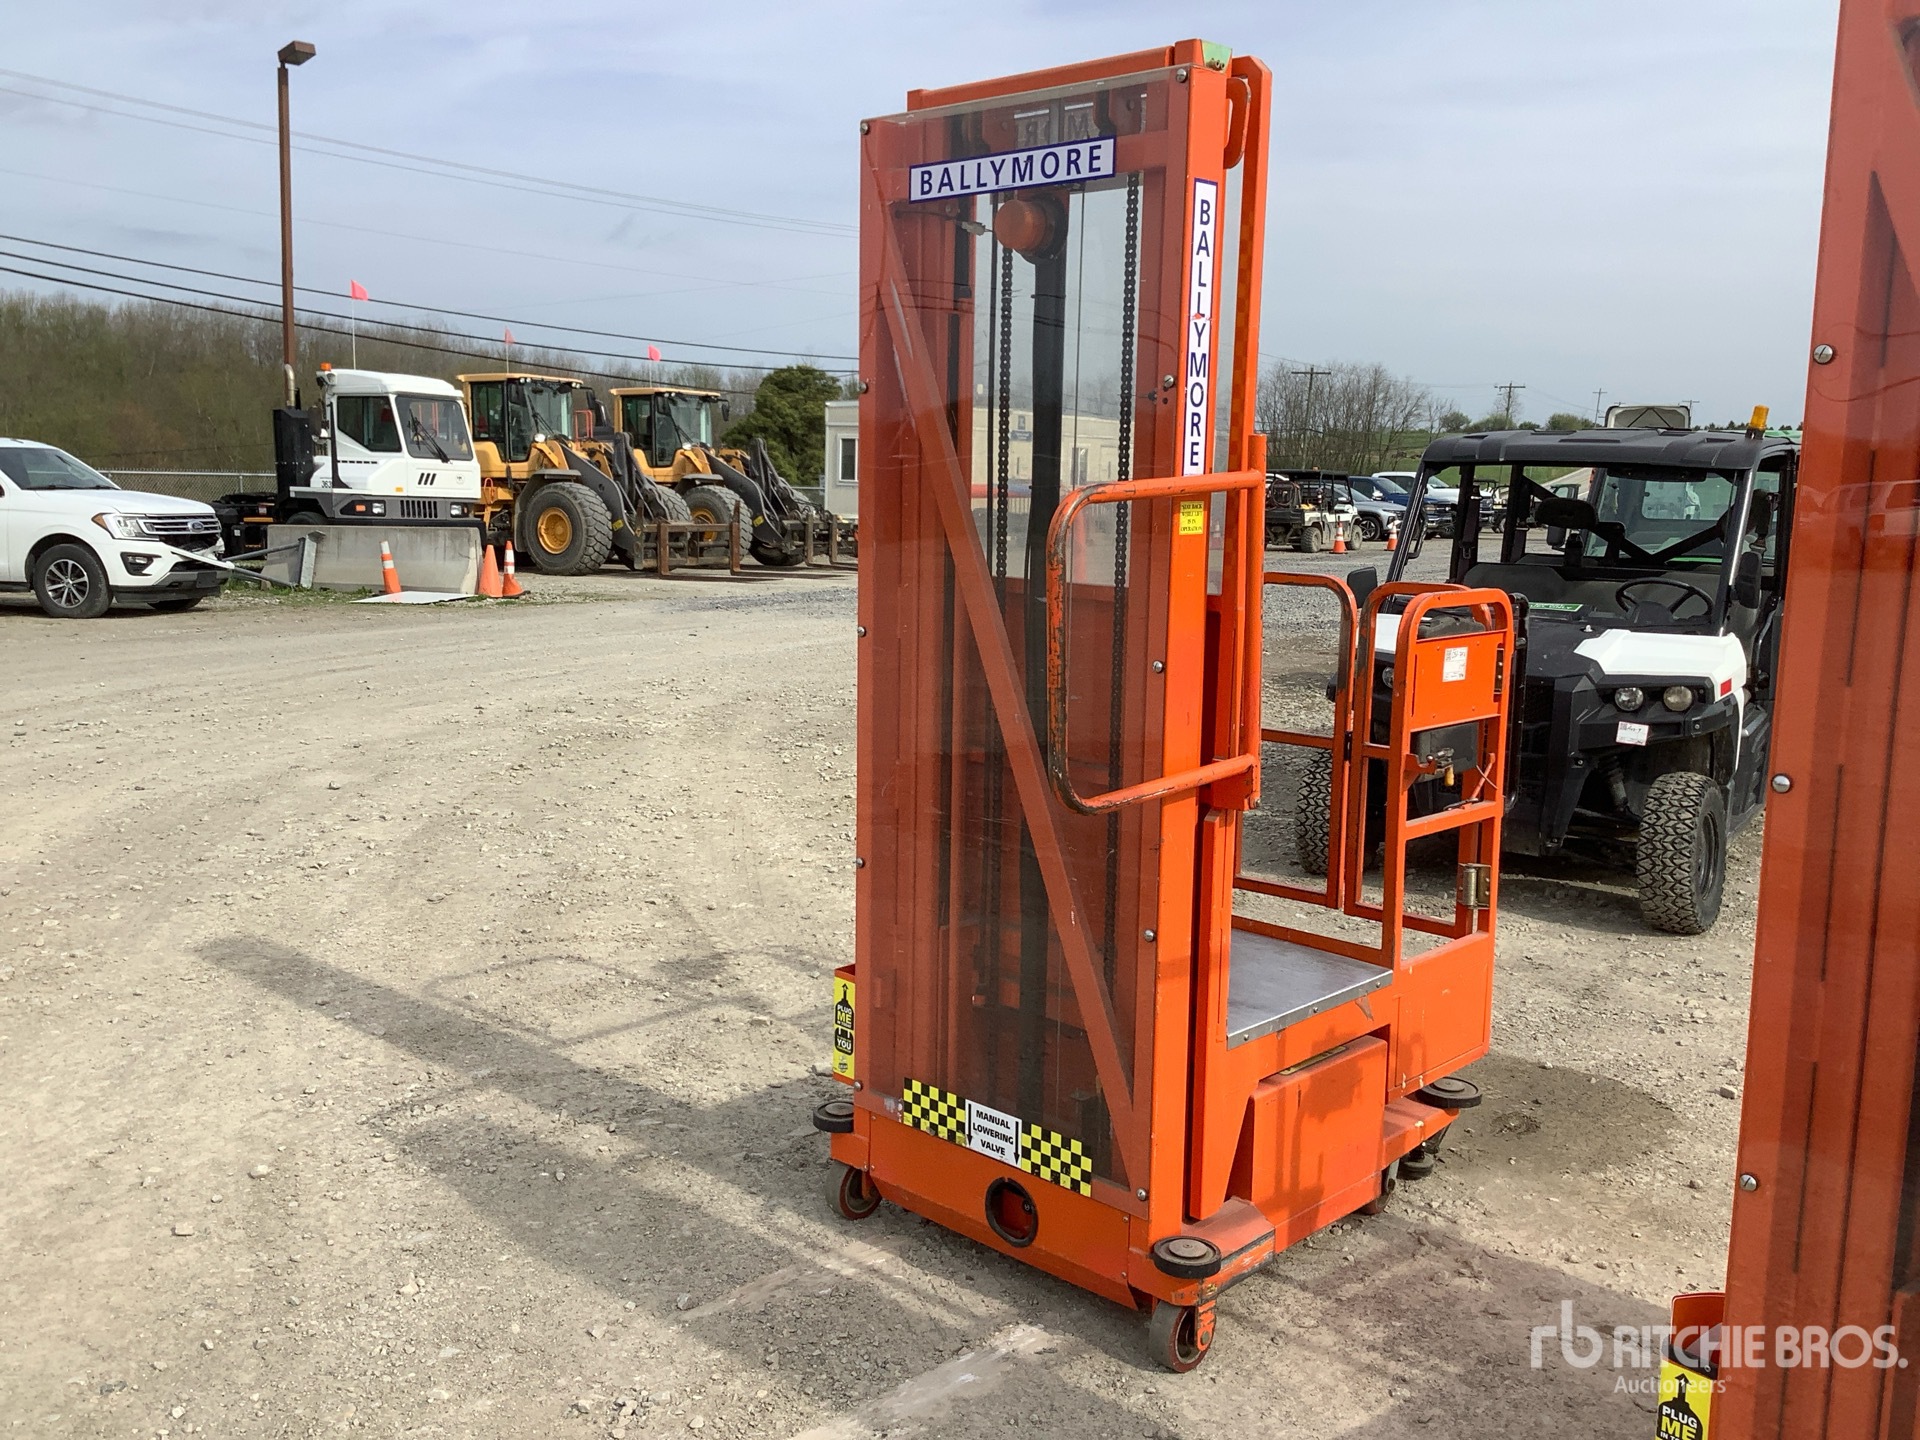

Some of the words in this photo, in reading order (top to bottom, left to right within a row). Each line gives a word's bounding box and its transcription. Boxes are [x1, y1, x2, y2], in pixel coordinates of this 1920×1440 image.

[920, 144, 1102, 196] BALLYMORE
[1189, 198, 1211, 468] BALLYMORE
[837, 1004, 852, 1014] PLUG
[837, 1010, 852, 1025] ME
[837, 1038, 852, 1050] YOU
[975, 1109, 1011, 1130] MANUAL
[972, 1122, 1014, 1146] LOWERING
[980, 1138, 1006, 1156] VALVE
[1662, 1404, 1698, 1429] PLUG
[1660, 1431, 1669, 1440] IN
[1661, 1415, 1698, 1440] ME
